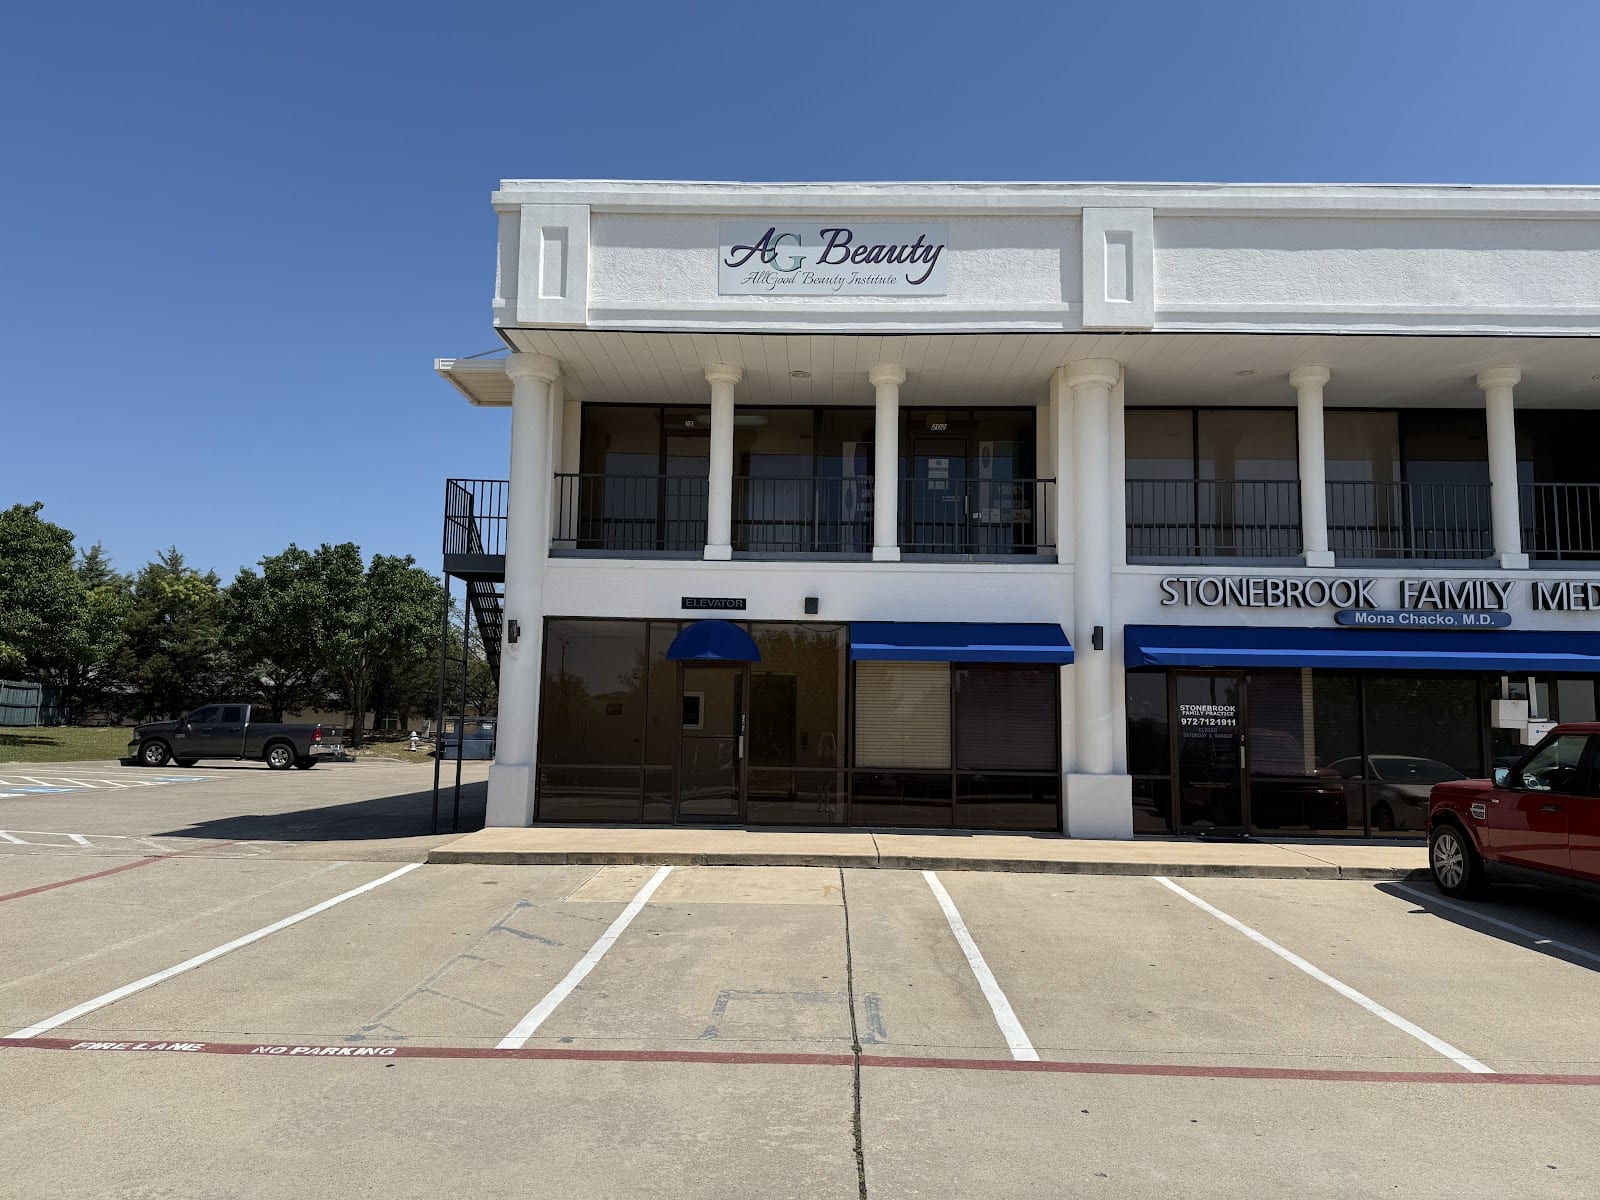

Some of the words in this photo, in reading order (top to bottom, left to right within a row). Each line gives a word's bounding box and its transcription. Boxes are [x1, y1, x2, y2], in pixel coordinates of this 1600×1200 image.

[724, 227, 806, 272] AG
[816, 228, 944, 285] Beauty
[740, 271, 799, 291] AllGood
[801, 271, 845, 291] Beauty
[846, 271, 897, 285] Institute
[1160, 576, 1380, 608] STONEBROOK
[1400, 580, 1516, 610] FAMILY
[686, 598, 743, 608] ELEVATOR
[1355, 612, 1395, 625] Mona
[1399, 612, 1458, 626] Chacko,
[1462, 613, 1495, 625] M.D.
[1180, 704, 1236, 712] STONEBROOK
[70, 1042, 134, 1051] FIRE
[132, 1042, 206, 1052] LANE
[251, 1046, 288, 1054] NO
[290, 1046, 397, 1056] PARKING
